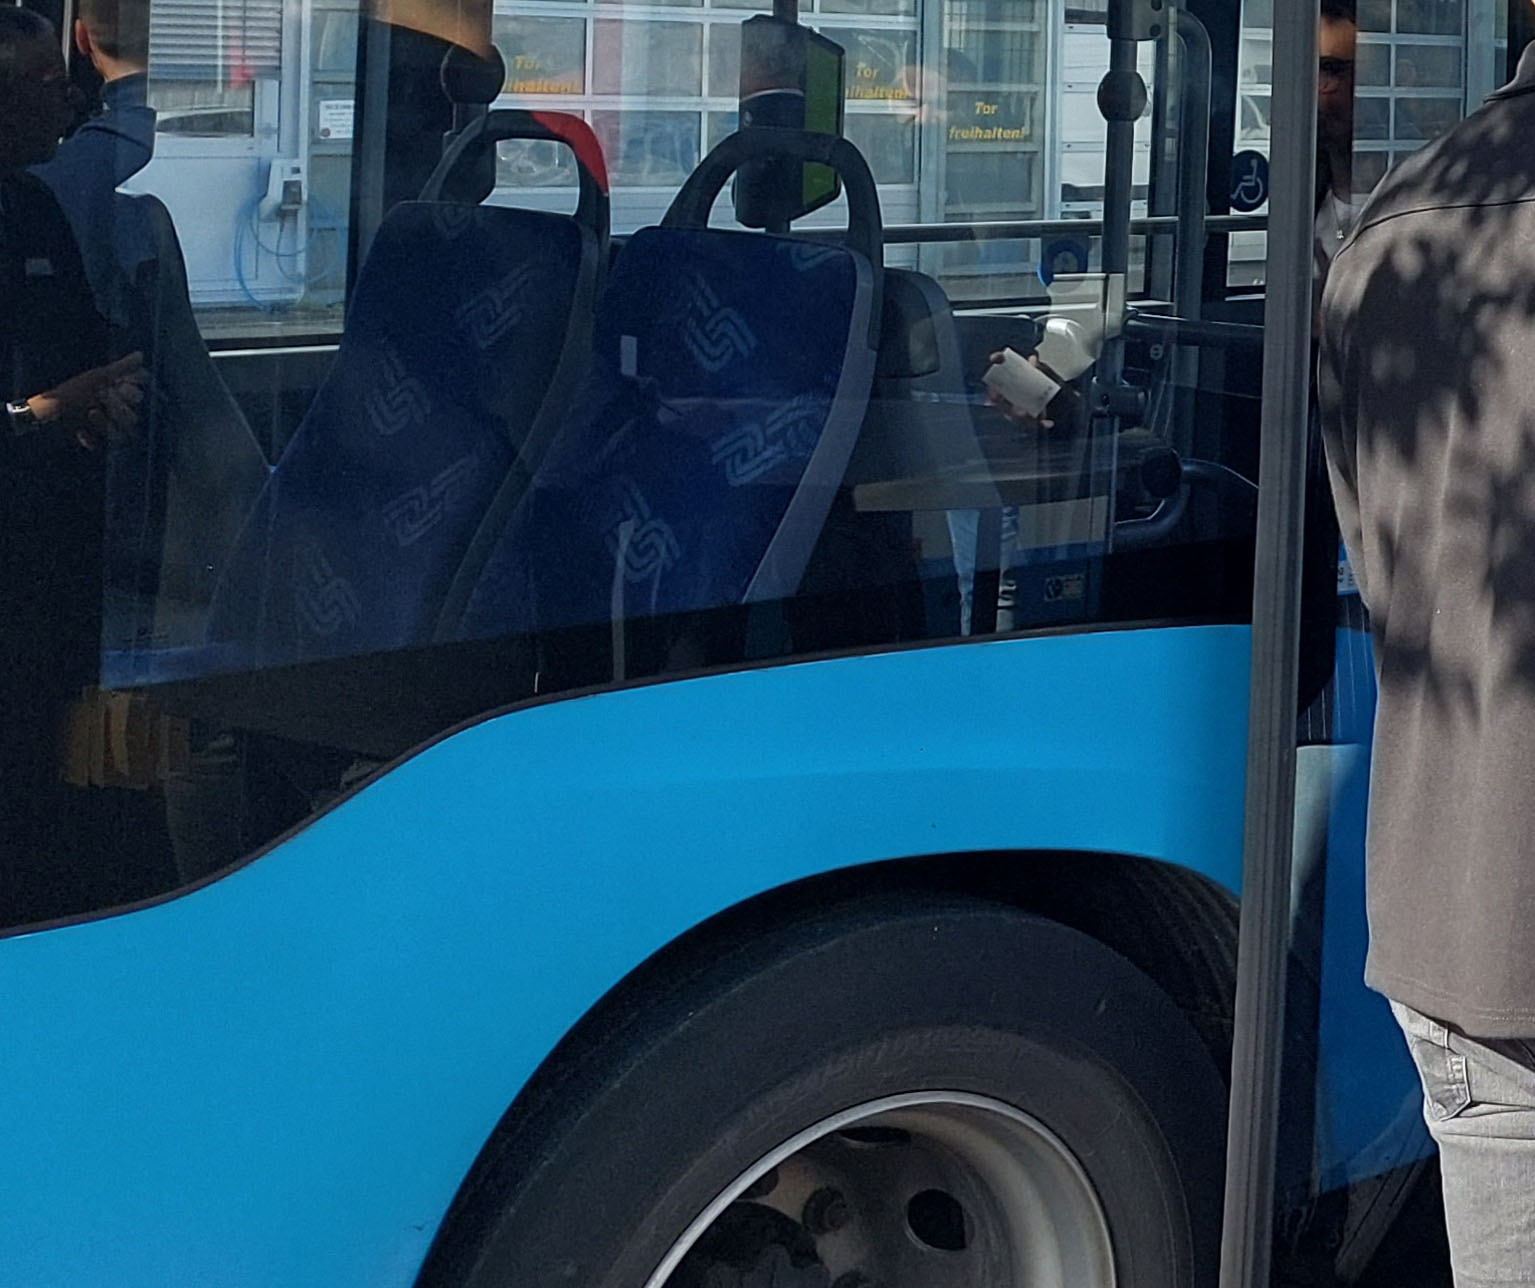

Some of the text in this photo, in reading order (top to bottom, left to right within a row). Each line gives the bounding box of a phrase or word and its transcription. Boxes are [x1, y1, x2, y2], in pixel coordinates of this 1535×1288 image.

[856, 62, 880, 78] Tor
[975, 101, 998, 116] Tor
[949, 126, 1025, 141] freihalten!
